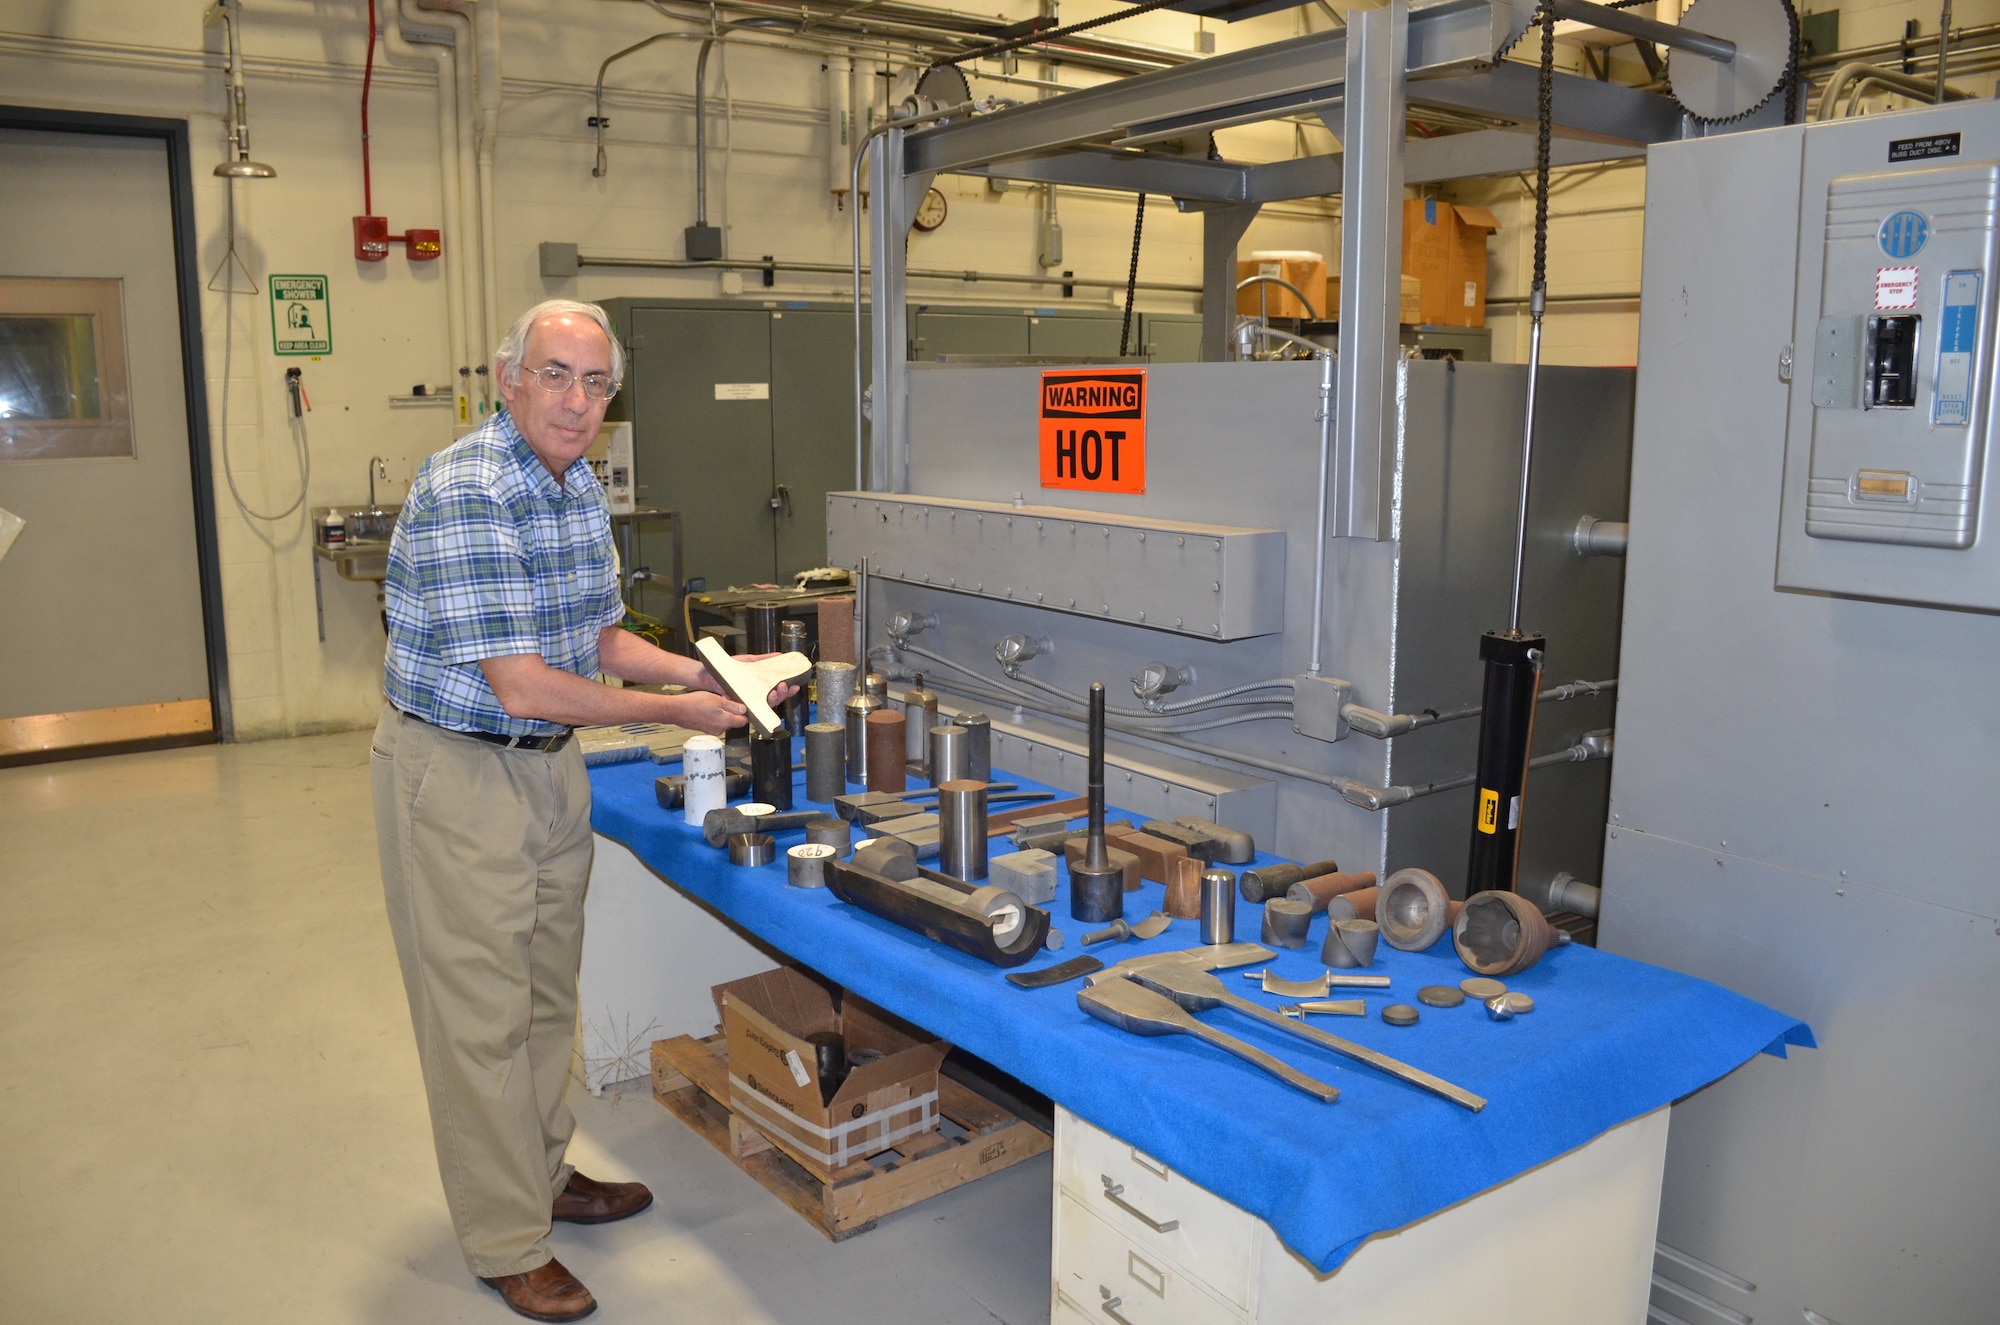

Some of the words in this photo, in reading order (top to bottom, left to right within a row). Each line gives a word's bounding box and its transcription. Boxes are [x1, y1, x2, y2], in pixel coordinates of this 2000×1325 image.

[1897, 143, 1913, 151] FEED
[1915, 140, 1932, 149] FROM
[1934, 138, 1952, 146] 480V
[1891, 151, 1908, 159] BUSS
[1909, 148, 1925, 156] DUCT
[276, 280, 322, 290] EMERGENCY
[283, 290, 317, 299] SHOWER
[1953, 306, 1962, 352] TRIPPED
[1048, 386, 1136, 407] WARNING
[1056, 429, 1126, 481] HOT
[745, 1029, 780, 1058] Safeguard
